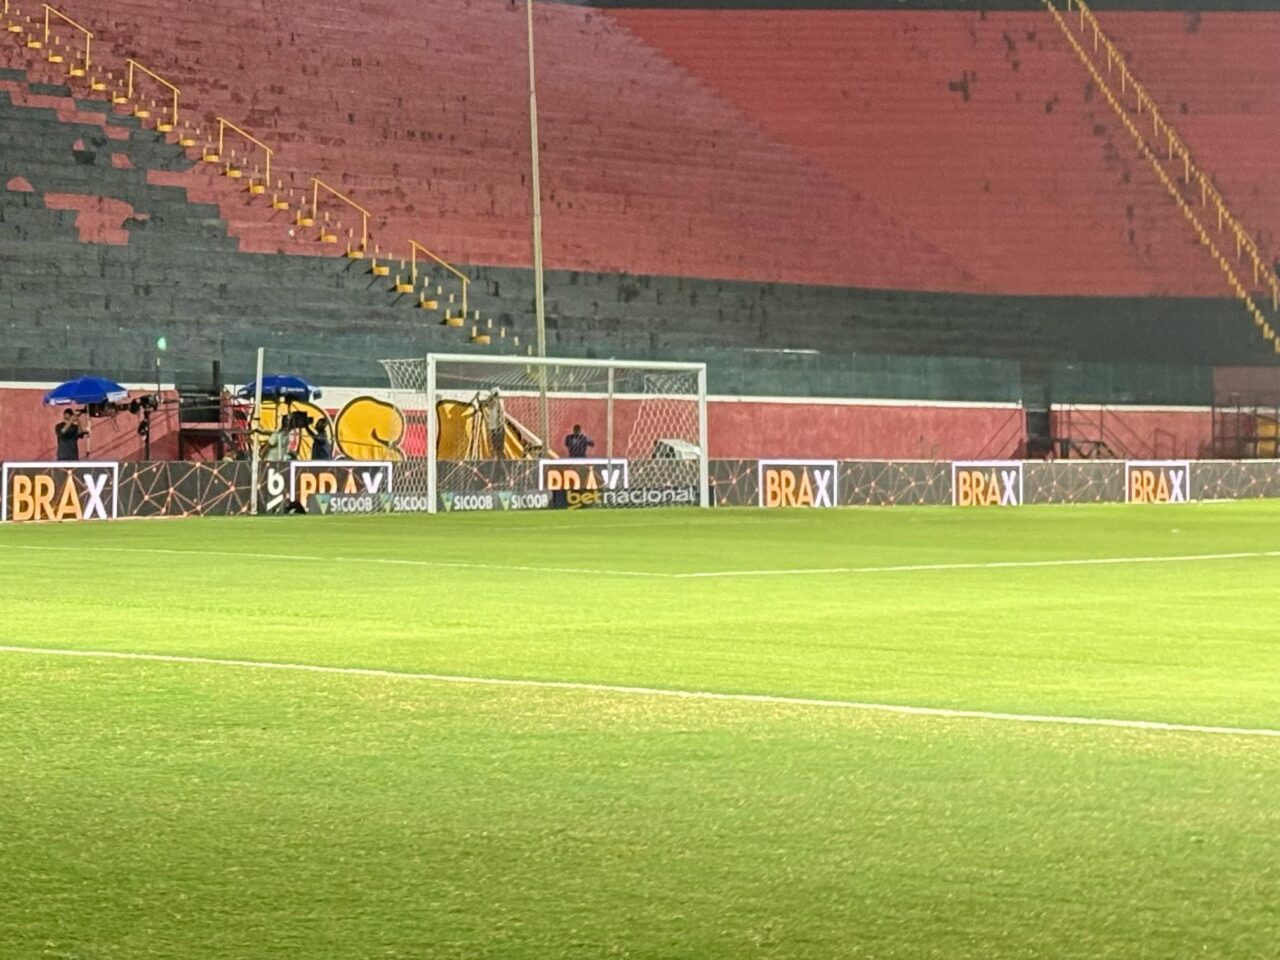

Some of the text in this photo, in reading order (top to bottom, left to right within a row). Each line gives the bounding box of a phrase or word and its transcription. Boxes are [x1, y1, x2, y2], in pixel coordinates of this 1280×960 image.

[12, 474, 108, 520] BRAX
[511, 494, 549, 509] SICOOB
[766, 469, 832, 507] BRAX
[959, 470, 1018, 506] BRAX
[1131, 470, 1186, 503] BRAX
[330, 496, 373, 512] SICOOB
[454, 496, 493, 511] SICOOB
